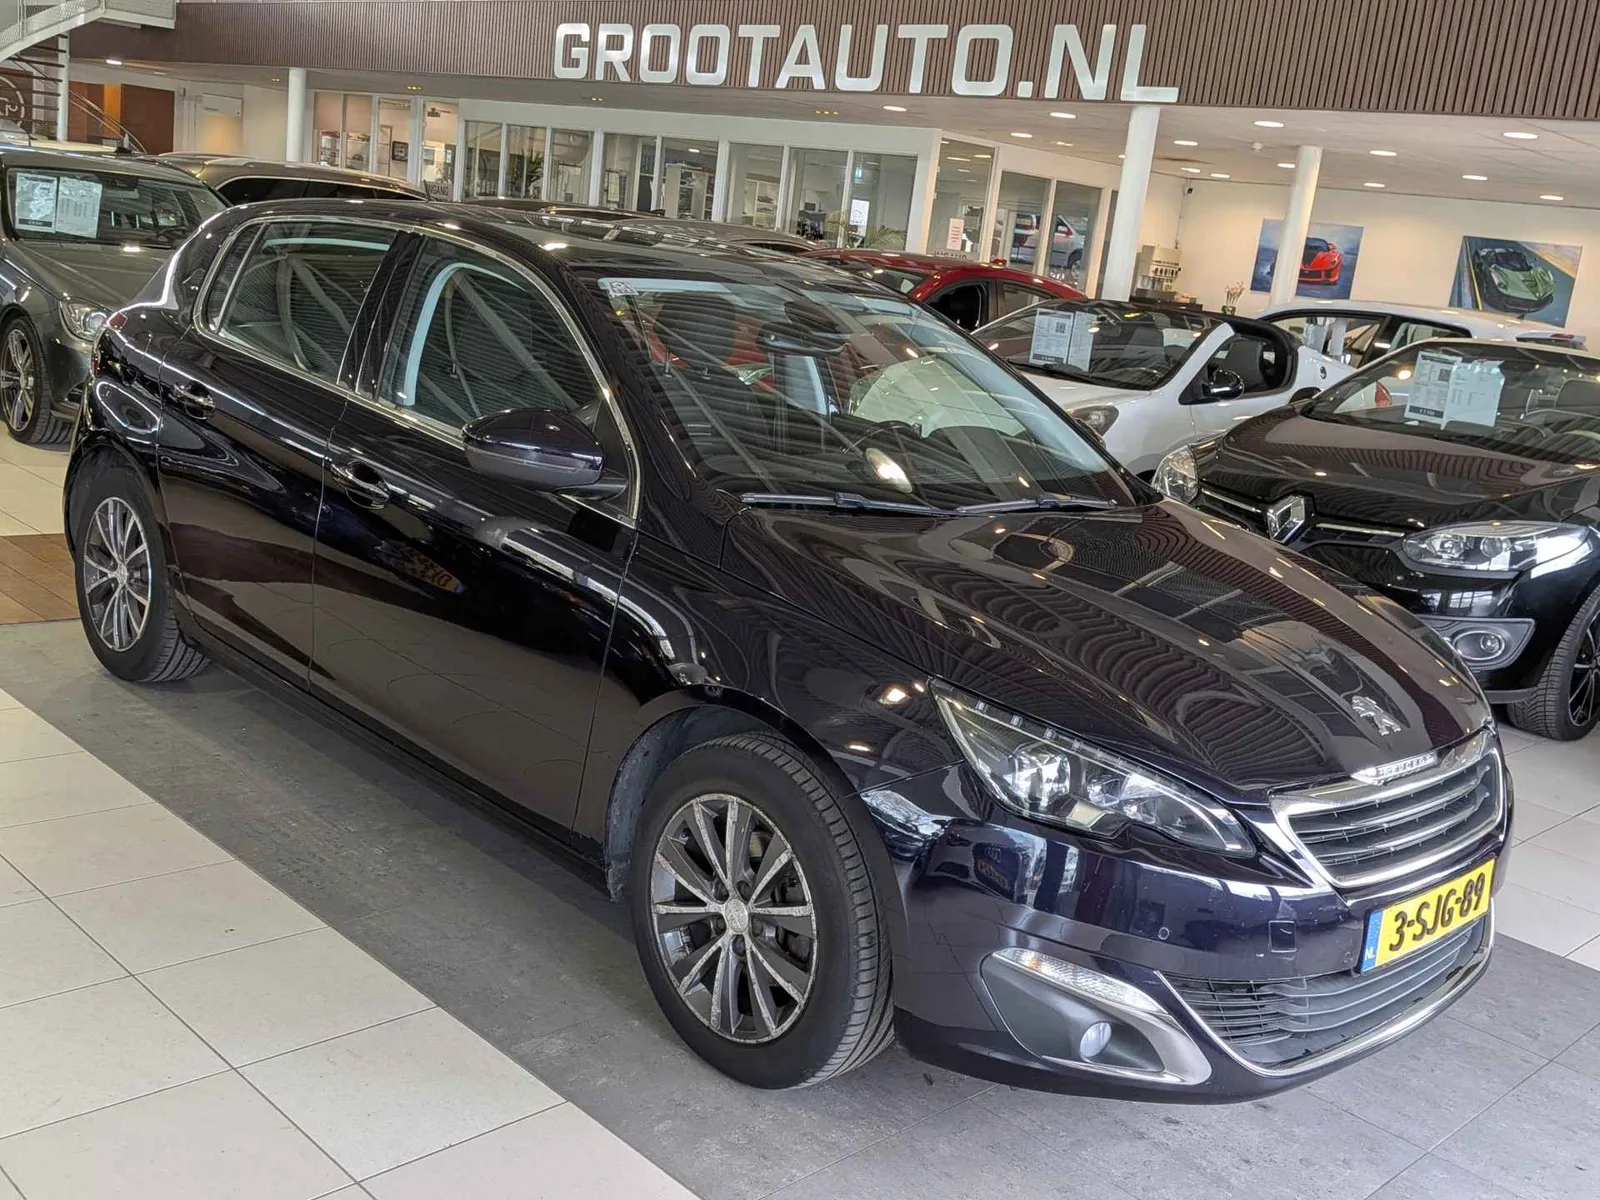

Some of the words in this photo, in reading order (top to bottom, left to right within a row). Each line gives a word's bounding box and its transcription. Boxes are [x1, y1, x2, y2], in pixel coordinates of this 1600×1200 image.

[554, 23, 1179, 102] GROOTAUTO.NL
[1389, 872, 1485, 951] 3-SJG-89
[1364, 946, 1376, 959] NL
